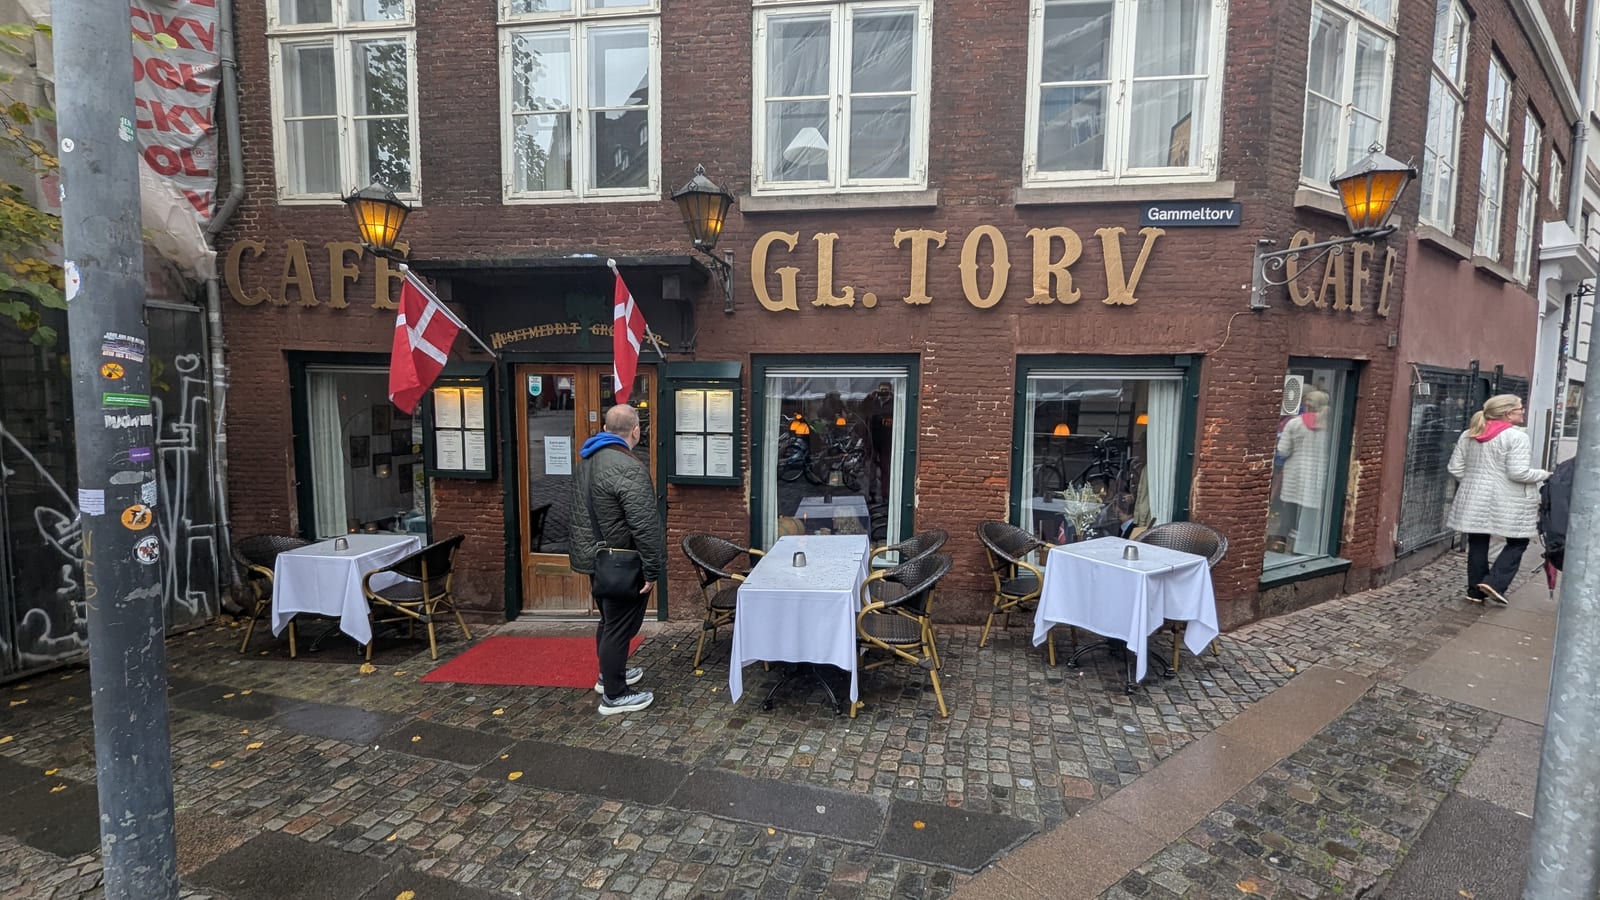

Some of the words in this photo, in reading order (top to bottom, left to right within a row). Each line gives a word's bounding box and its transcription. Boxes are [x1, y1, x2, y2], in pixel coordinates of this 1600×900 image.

[1147, 206, 1235, 221] Gammeltorv
[751, 230, 878, 312] GL.
[892, 224, 1167, 309] TORV
